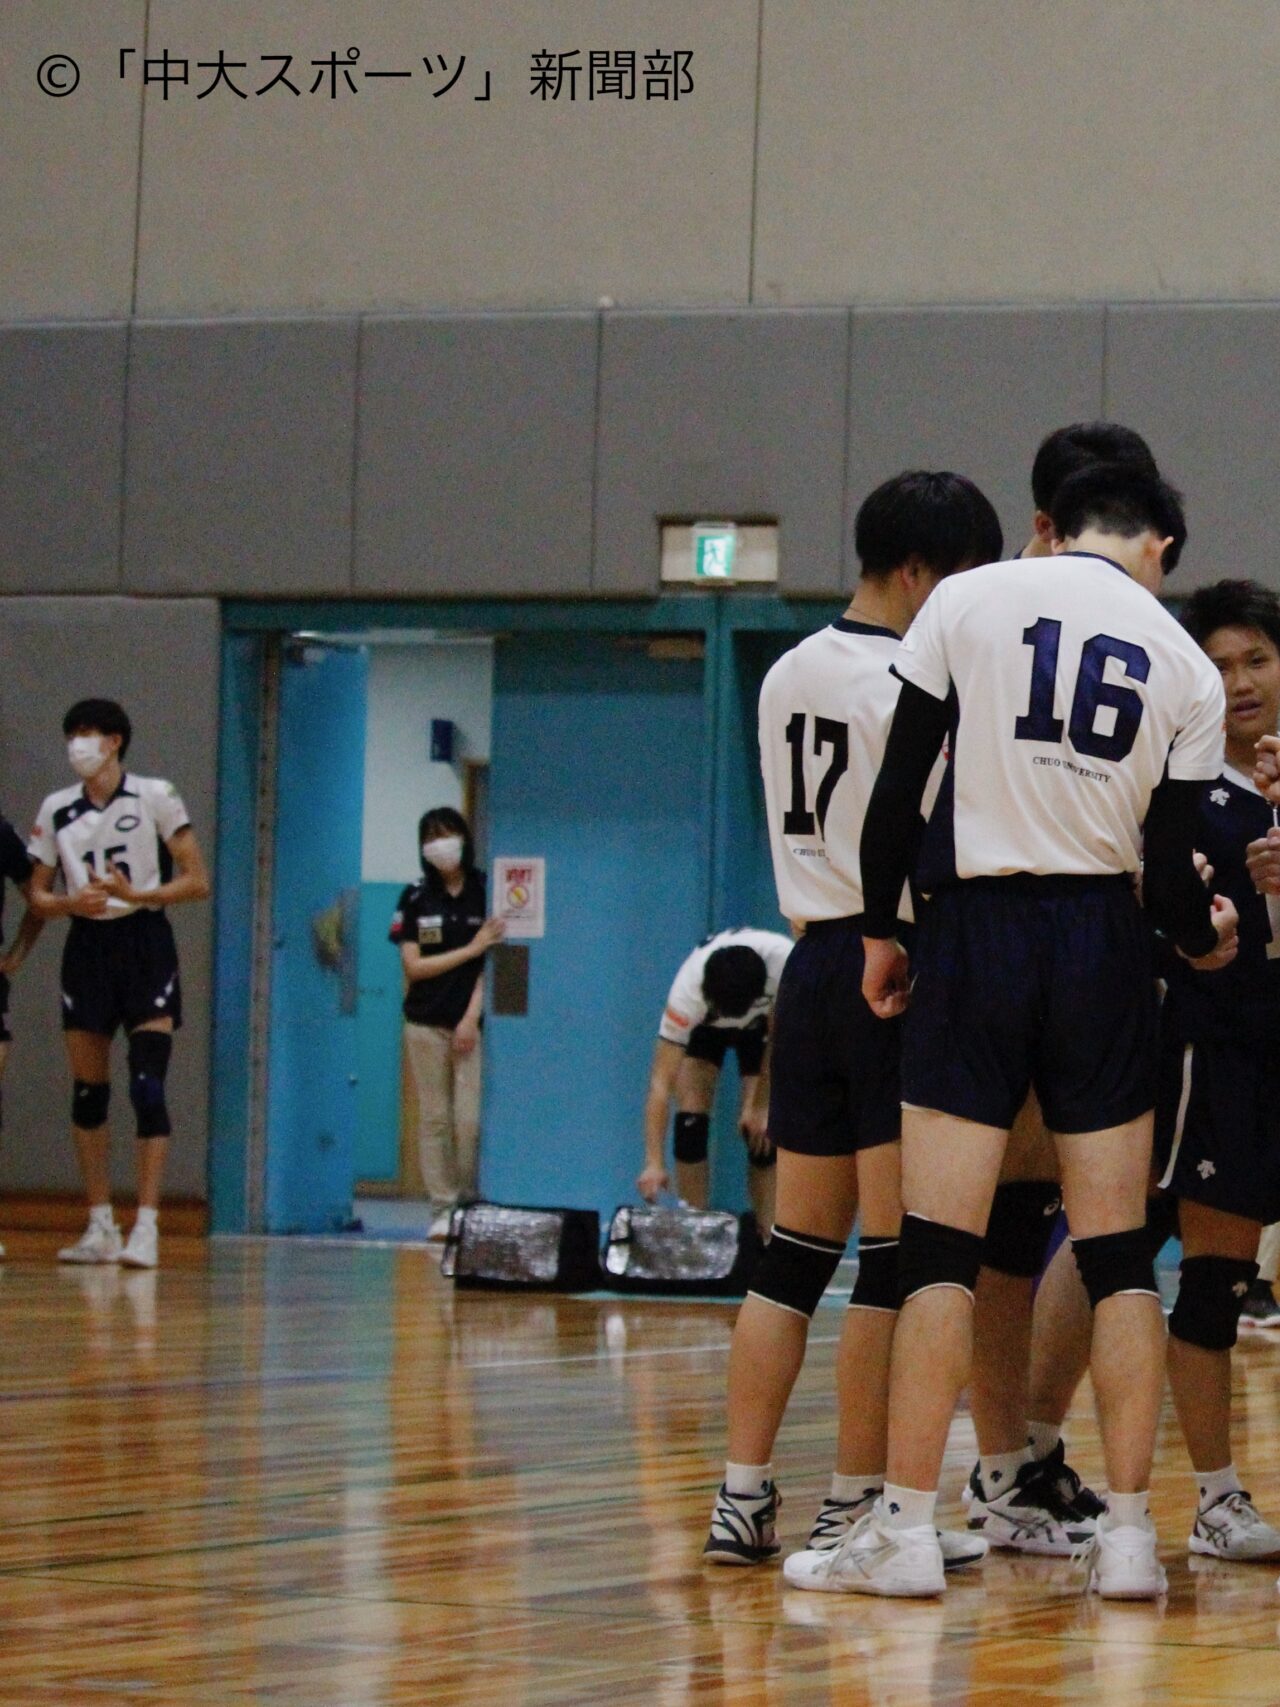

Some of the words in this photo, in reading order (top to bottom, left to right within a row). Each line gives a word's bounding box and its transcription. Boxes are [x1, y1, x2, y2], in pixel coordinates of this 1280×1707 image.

[1014, 616, 1152, 763] 16
[783, 712, 850, 844] 17
[1032, 756, 1061, 767] CHUO
